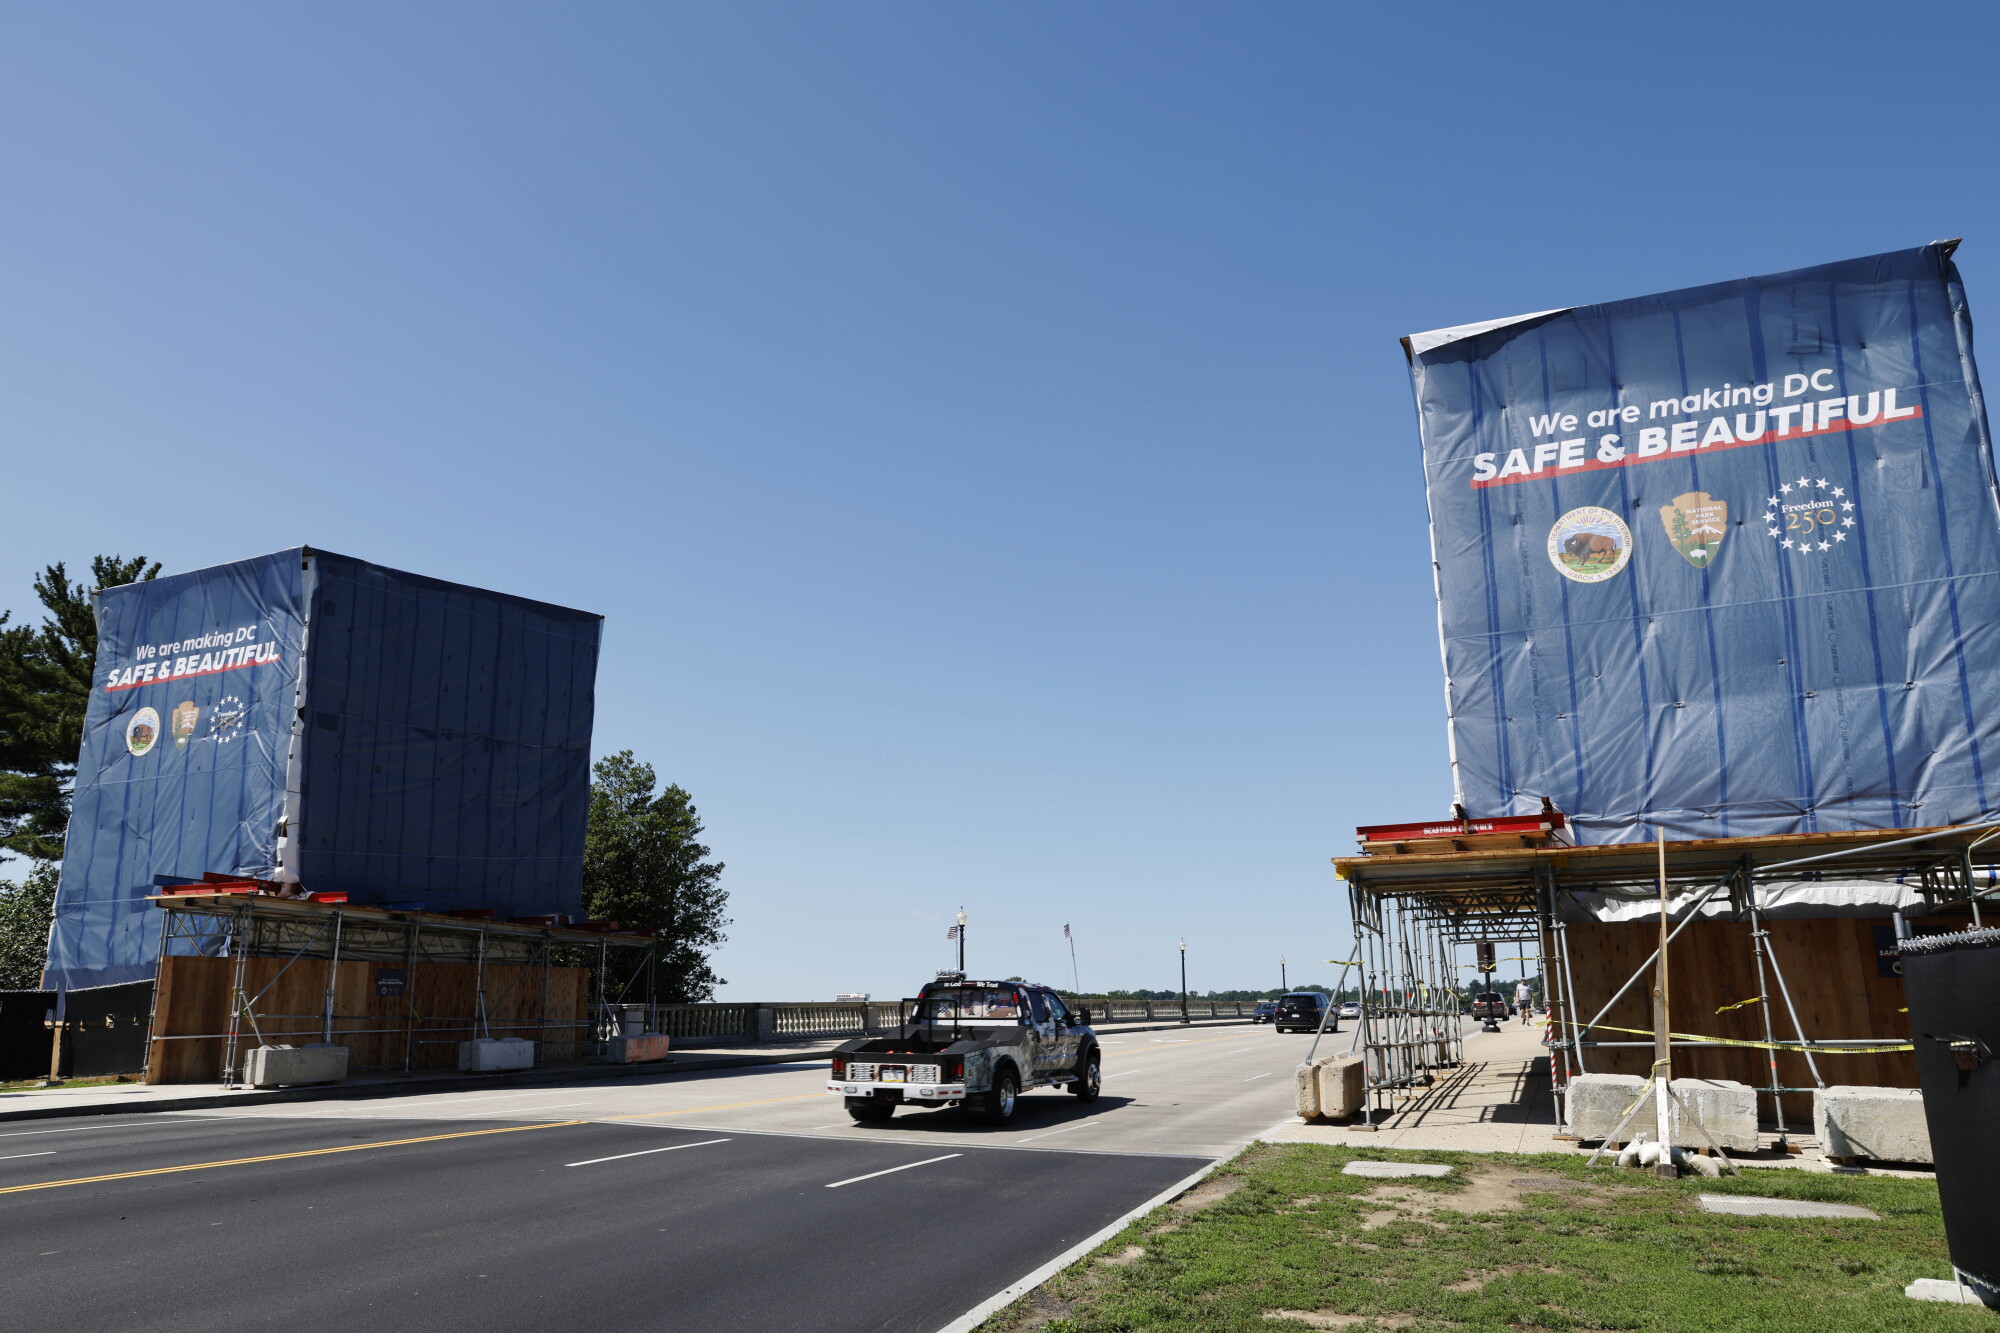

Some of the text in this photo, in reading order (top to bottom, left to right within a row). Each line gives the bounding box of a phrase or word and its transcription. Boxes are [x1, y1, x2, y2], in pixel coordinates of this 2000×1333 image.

[1529, 412, 1578, 437] We
[1587, 405, 1640, 428] are
[1650, 382, 1774, 419] making
[1784, 368, 1835, 398] DC
[1472, 437, 1586, 482] SAFE
[1596, 433, 1626, 463] &
[1638, 387, 1915, 458] BEAUTIFUL
[1686, 505, 1723, 514] NATIONAL
[1781, 499, 1834, 514] Freedom
[1550, 508, 1586, 542] DEPARTMENT
[1601, 510, 1615, 520] THE
[1614, 518, 1631, 547] INTERIOR
[1691, 517, 1721, 525] SERVICE
[1785, 508, 1837, 534] 250
[1566, 570, 1594, 581] MARCH
[1605, 564, 1621, 577] 1849
[136, 625, 257, 660] We are making DC
[107, 641, 279, 688] SAFE & BEAUTIFUL
[1424, 826, 1457, 834] SCAFFOLD
